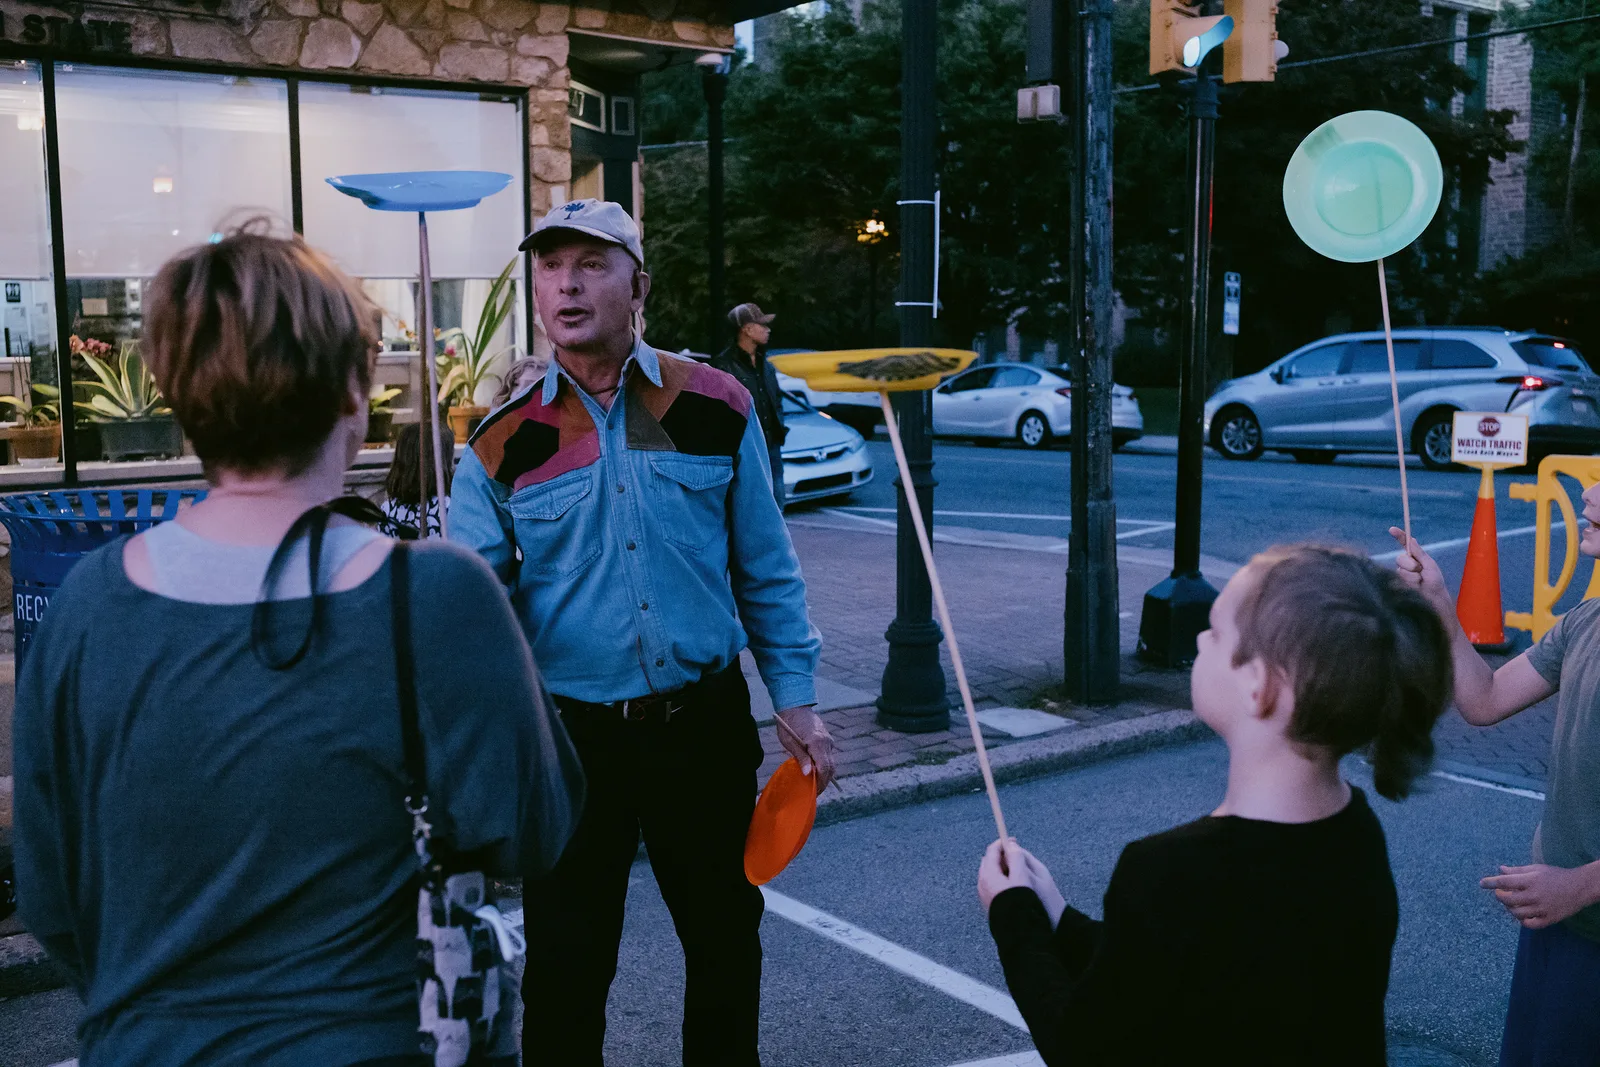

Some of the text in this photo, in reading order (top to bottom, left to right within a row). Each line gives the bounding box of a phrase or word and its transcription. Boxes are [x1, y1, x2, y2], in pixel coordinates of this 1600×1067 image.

[23, 13, 133, 51] STATE
[1479, 421, 1500, 432] STOP
[1457, 438, 1522, 450] WATCH TRAFFIC
